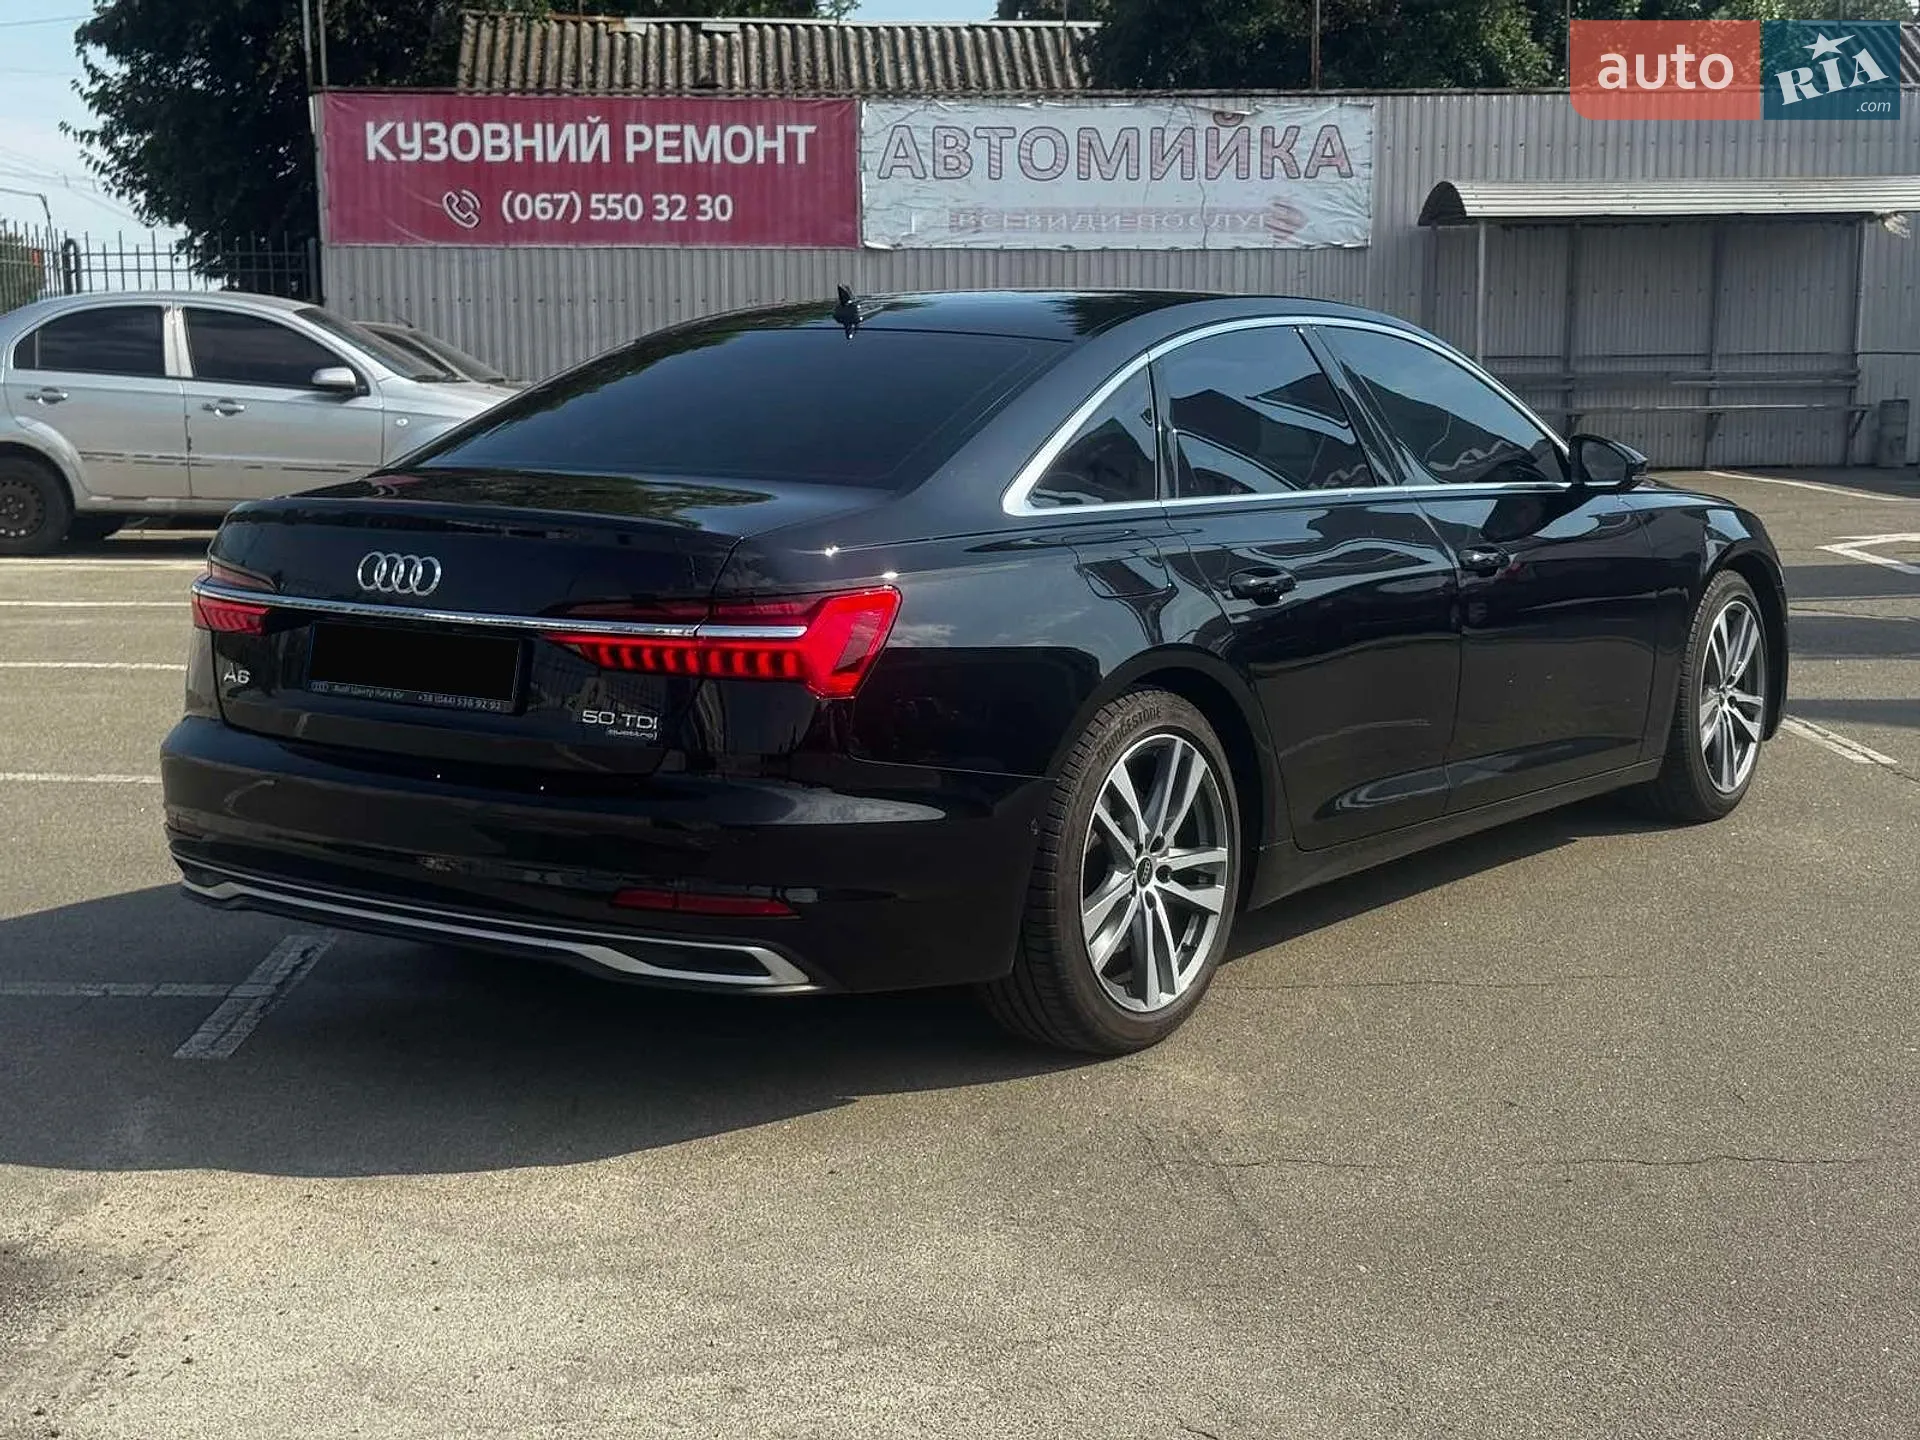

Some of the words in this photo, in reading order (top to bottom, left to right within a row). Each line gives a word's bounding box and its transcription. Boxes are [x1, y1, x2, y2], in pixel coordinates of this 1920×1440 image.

[366, 116, 610, 163] КУЗОВНИЙ
[626, 123, 816, 165] РЕМОНТ
[877, 110, 1354, 182] АВТОМИЙКА
[501, 190, 582, 225] (067)
[590, 193, 644, 222] 550
[652, 194, 688, 222] 32
[696, 194, 733, 222] 30
[224, 667, 251, 684] A6
[582, 710, 615, 725] 50
[622, 714, 658, 729] TDI
